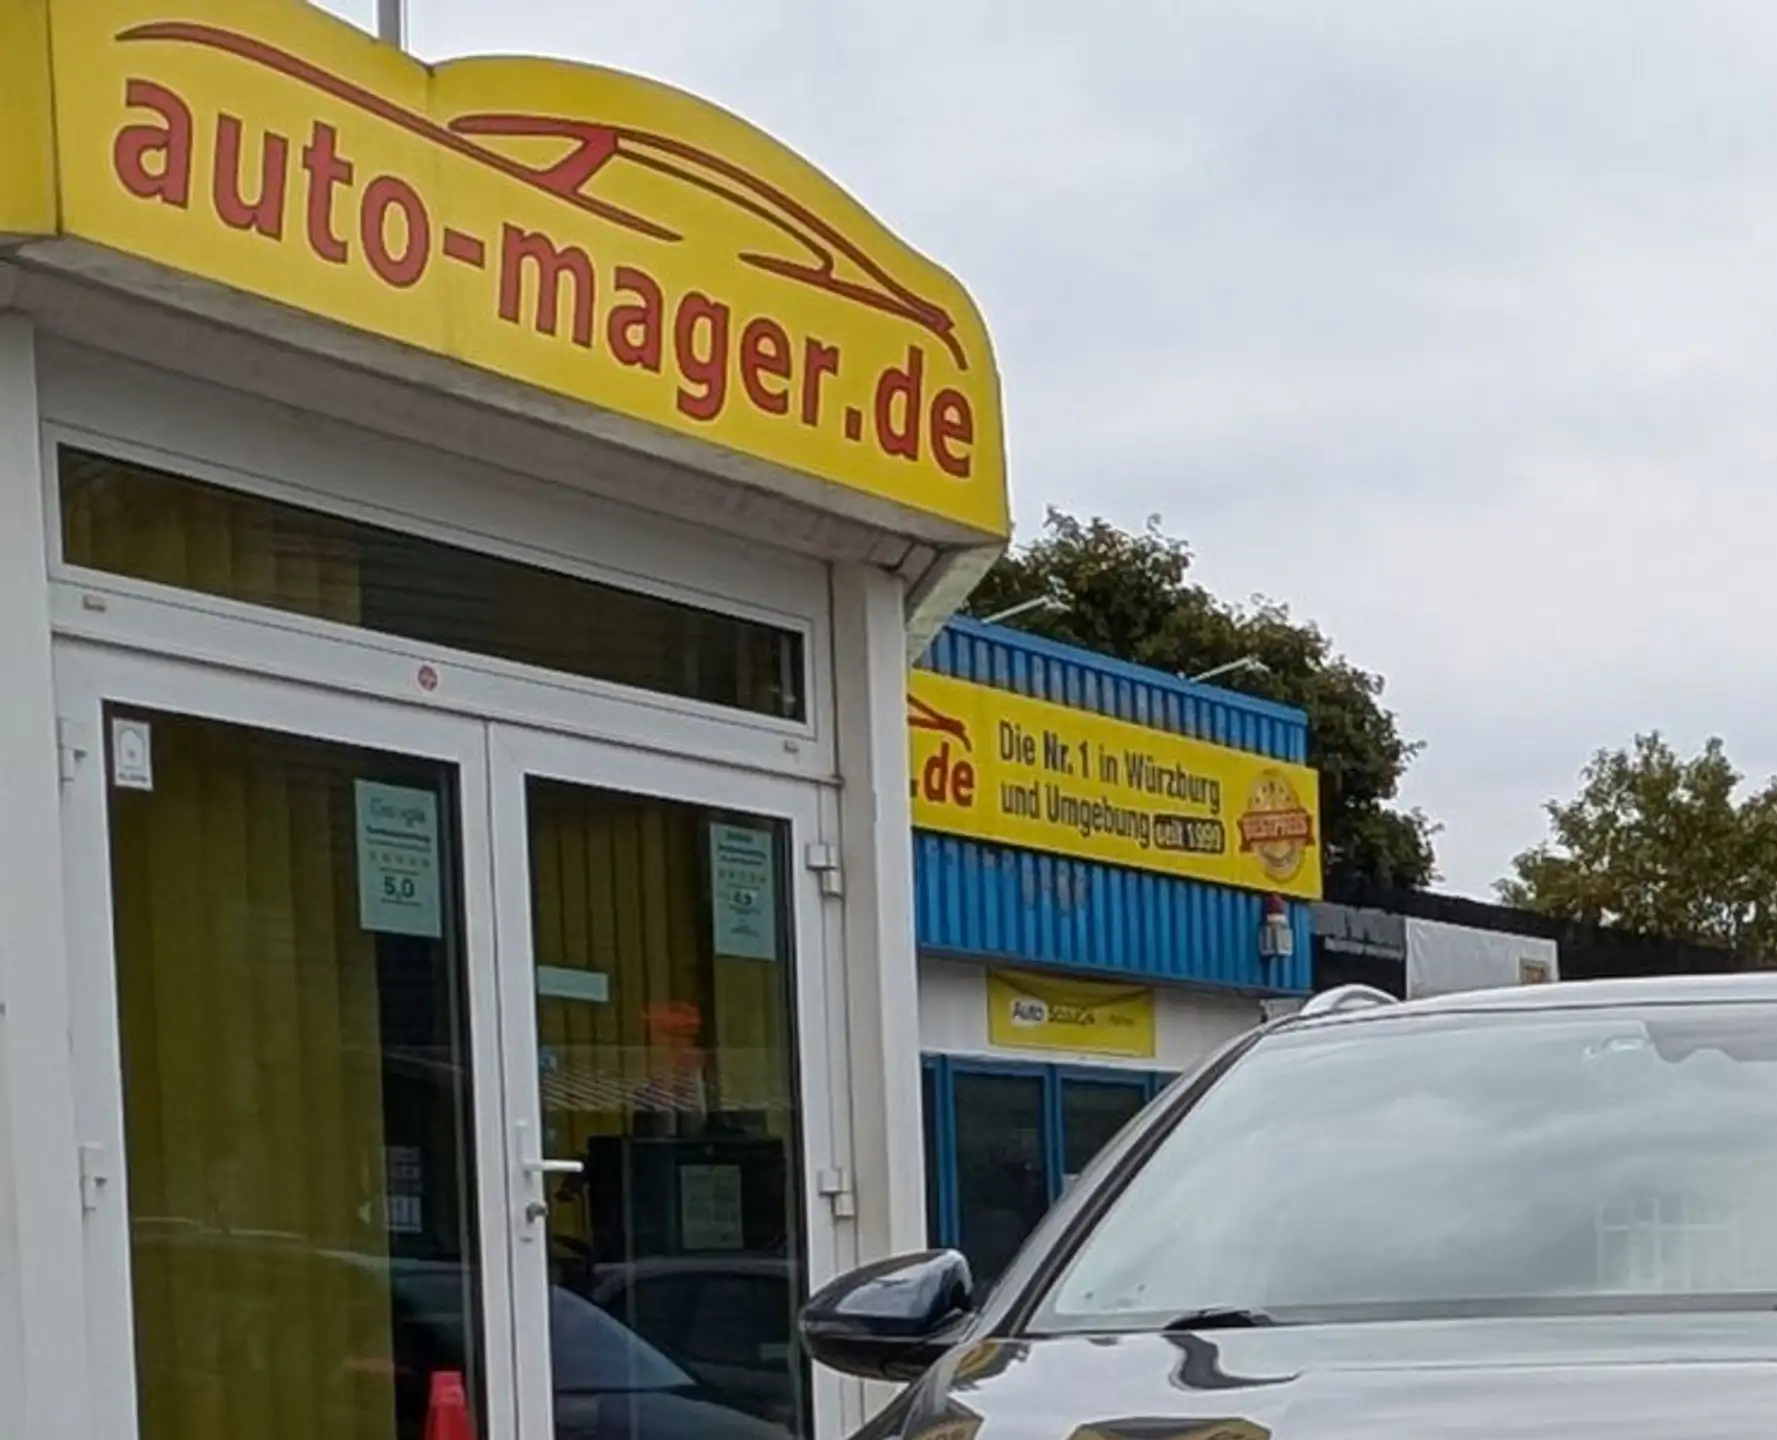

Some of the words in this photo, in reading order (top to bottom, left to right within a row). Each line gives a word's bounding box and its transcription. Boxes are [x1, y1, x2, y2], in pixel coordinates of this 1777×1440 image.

[113, 77, 974, 478] auto-mager.de
[999, 720, 1036, 766] Die
[1043, 730, 1074, 774] Nr.
[1078, 740, 1089, 778] 1
[1098, 745, 1118, 785] in
[1124, 751, 1221, 814] Würzburg
[1001, 781, 1040, 819] und
[1046, 784, 1150, 848] Umgebung
